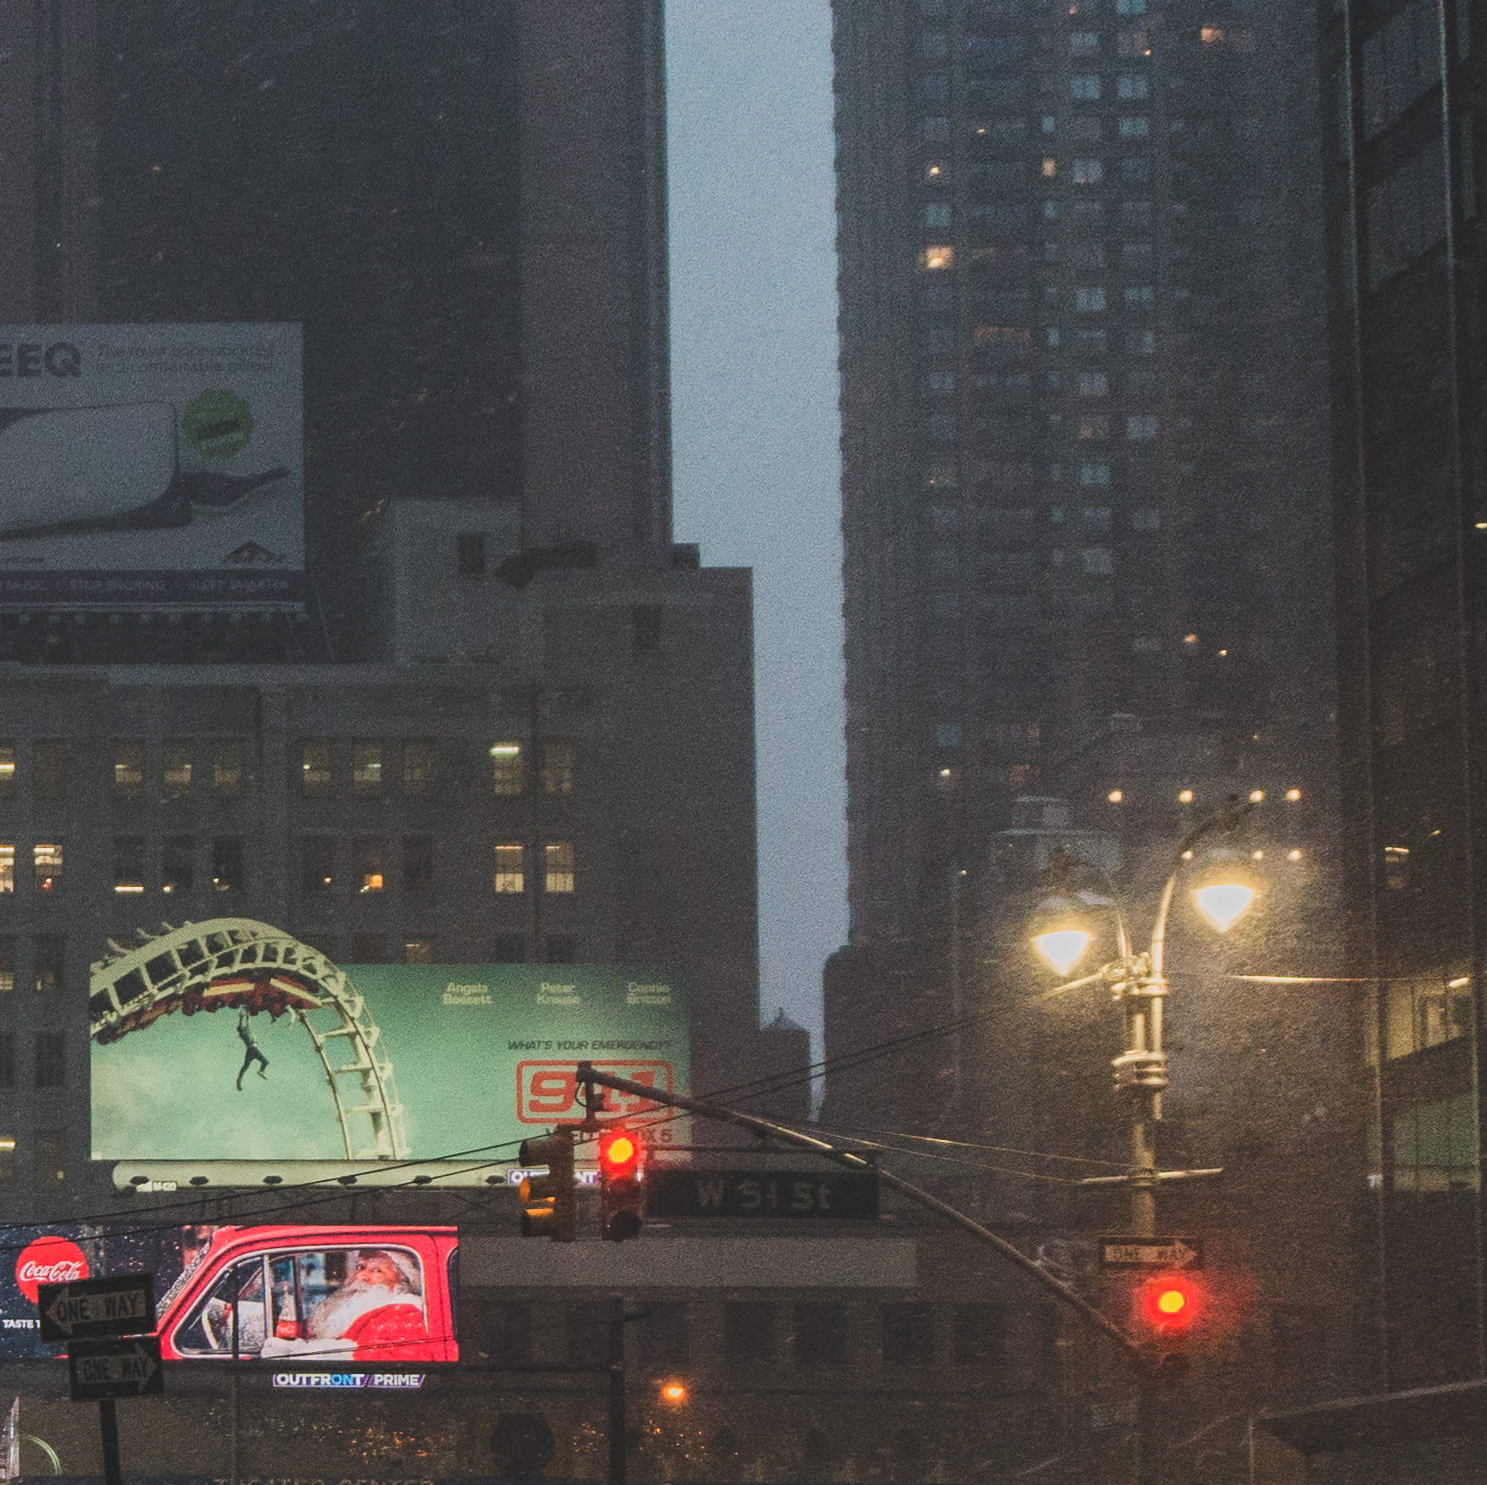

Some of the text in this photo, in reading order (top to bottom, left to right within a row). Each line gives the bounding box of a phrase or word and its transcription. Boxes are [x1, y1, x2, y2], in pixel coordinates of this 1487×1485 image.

[556, 1040, 589, 1051] YOUR
[696, 1178, 833, 1211] W 51 St
[19, 1260, 85, 1282] Coca-Cola
[57, 1291, 139, 1322] ONE WAY
[2, 1319, 35, 1330] TASTE
[82, 1355, 147, 1381] ONE WAY
[275, 1373, 422, 1387] OUTFRONT PRIME
